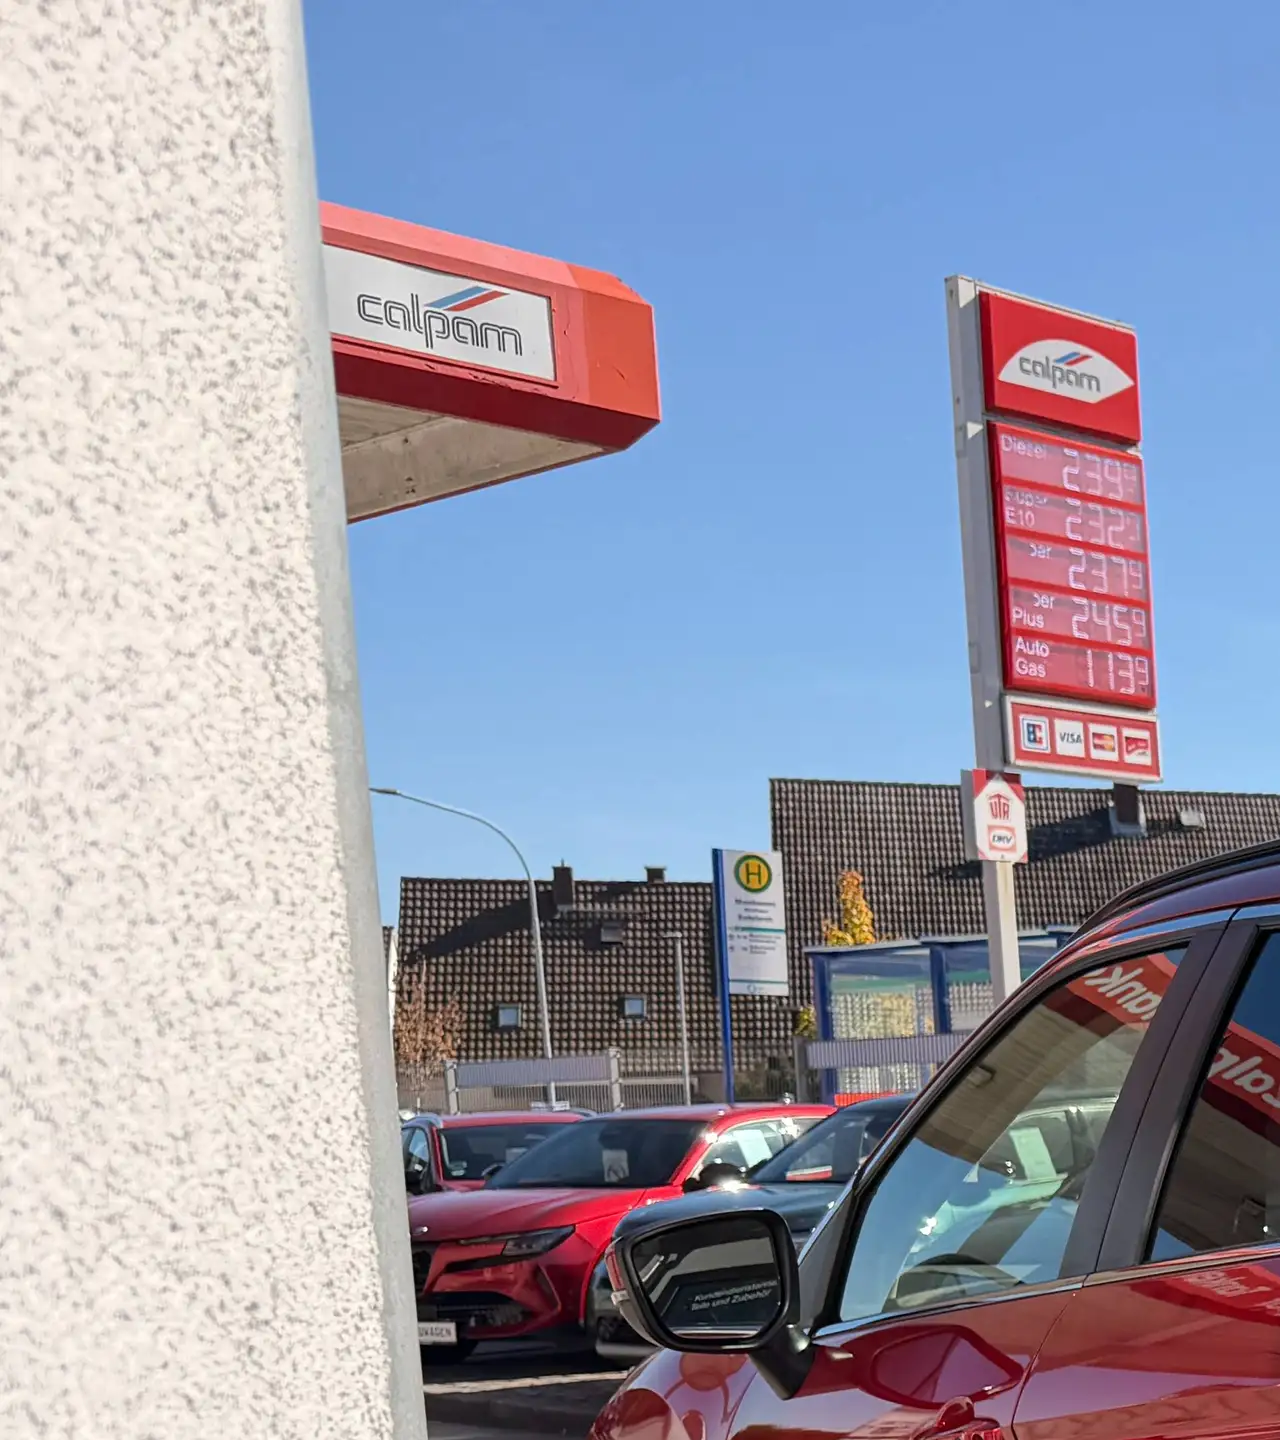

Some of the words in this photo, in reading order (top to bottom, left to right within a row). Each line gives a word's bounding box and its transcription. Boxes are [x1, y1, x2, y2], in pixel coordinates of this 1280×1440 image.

[357, 292, 523, 357] calpam
[1018, 356, 1101, 394] calpam
[1005, 507, 1035, 528] E10
[1012, 607, 1045, 629] Plus
[1015, 635, 1050, 658] Auto
[1015, 658, 1047, 678] Gas
[1059, 732, 1083, 744] VISA
